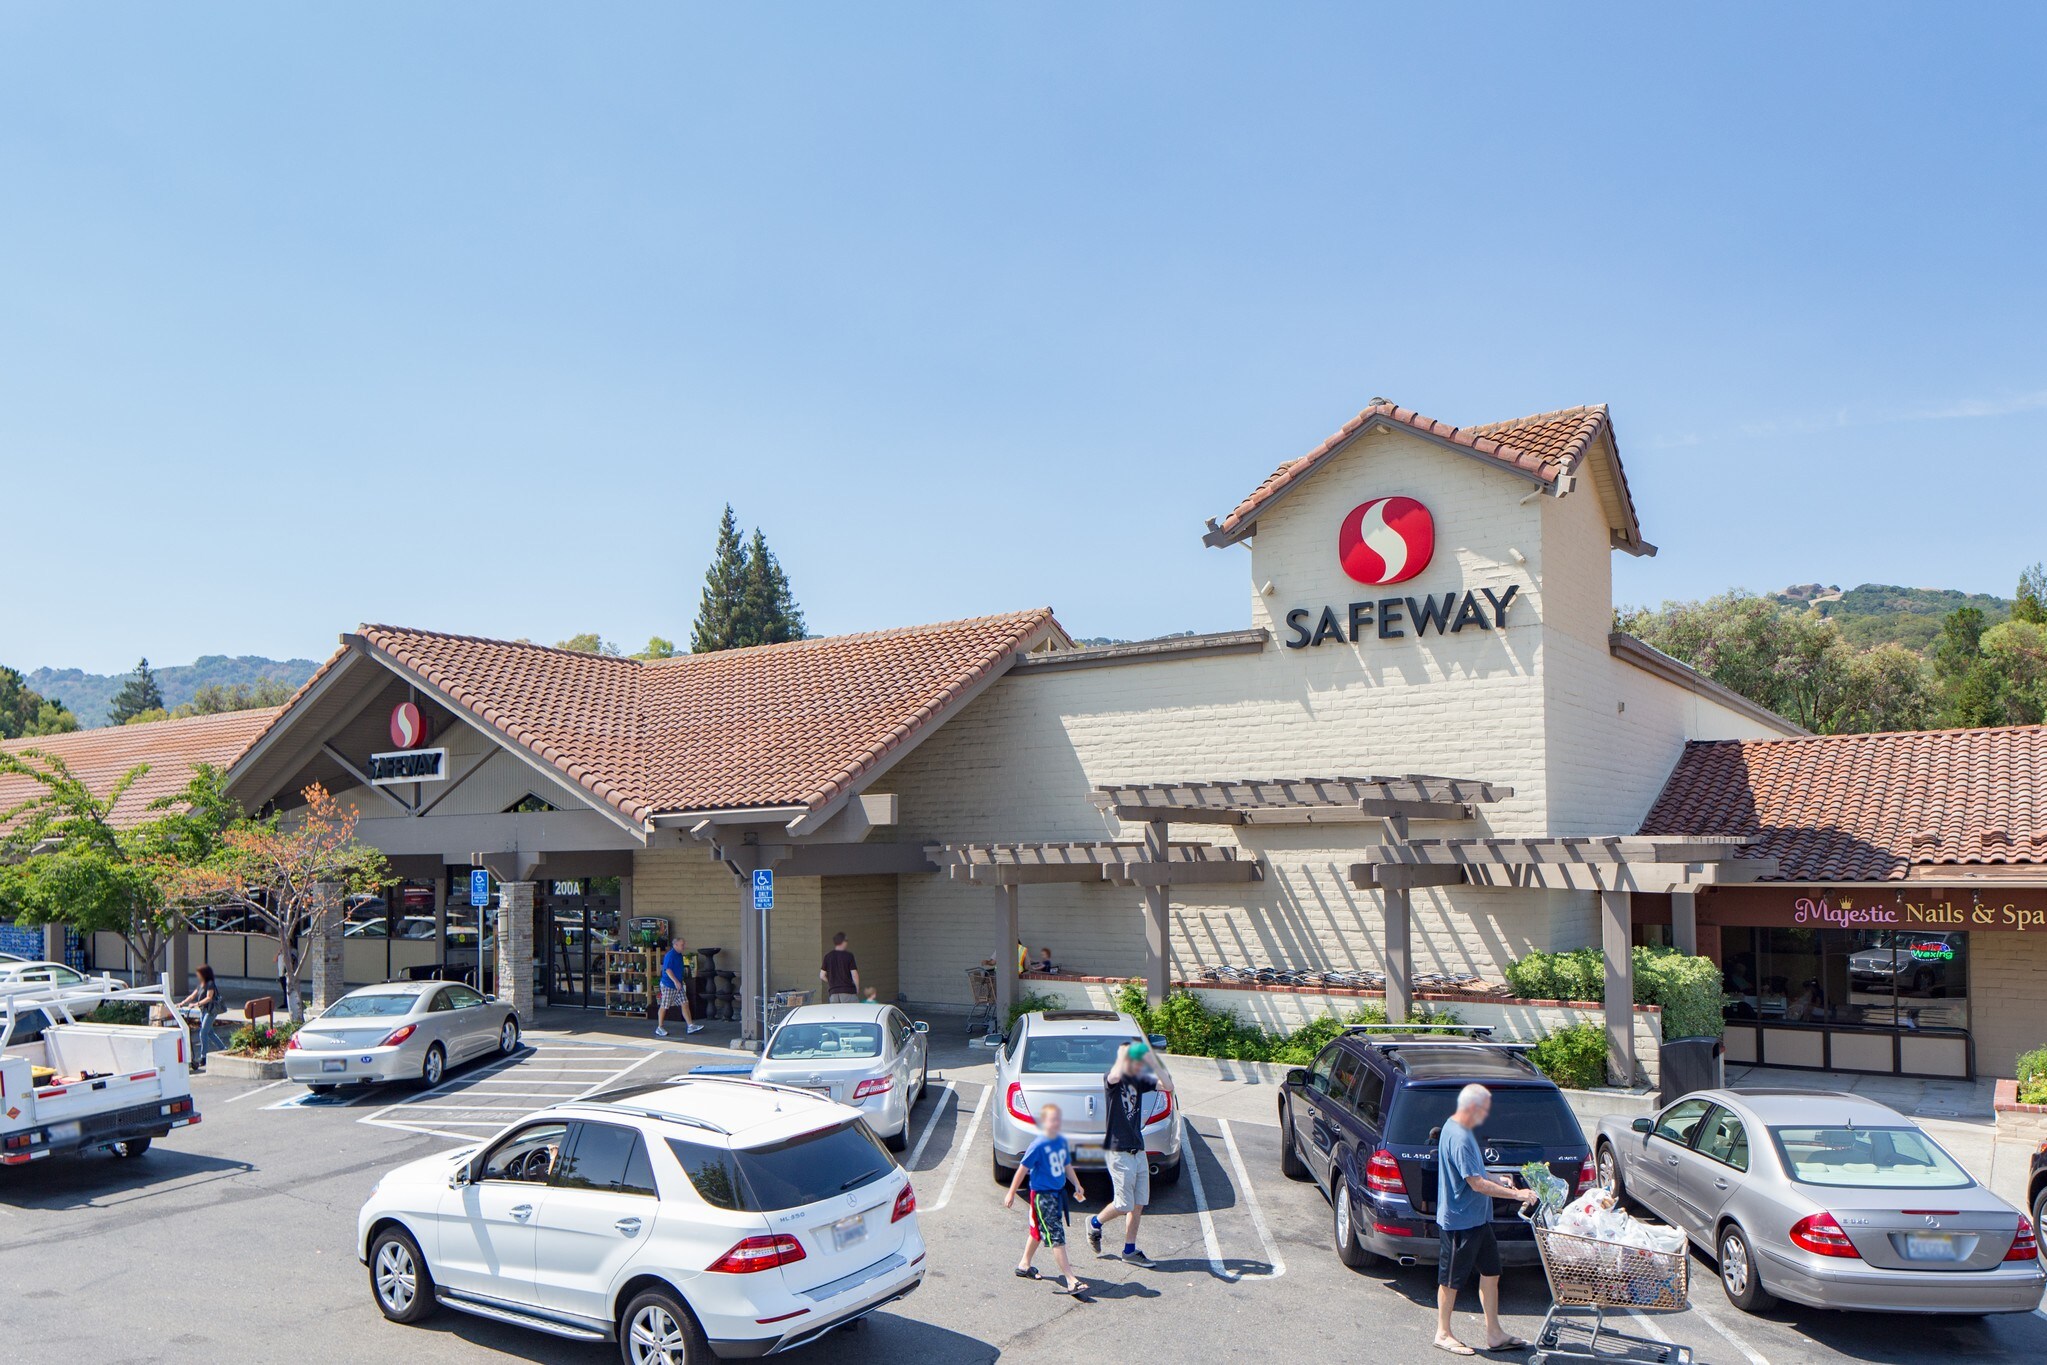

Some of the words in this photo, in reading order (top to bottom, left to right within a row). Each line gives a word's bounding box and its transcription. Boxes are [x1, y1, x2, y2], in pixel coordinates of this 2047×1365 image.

[1286, 585, 1519, 649] SAFEWAY
[367, 752, 442, 779] SAFEWAY
[554, 881, 581, 896] 200A
[1794, 897, 1899, 928] Majestic
[1905, 902, 1965, 924] Nails
[1971, 903, 1995, 924] &
[2002, 903, 2046, 931] Spa
[1912, 950, 1954, 960] Waxing
